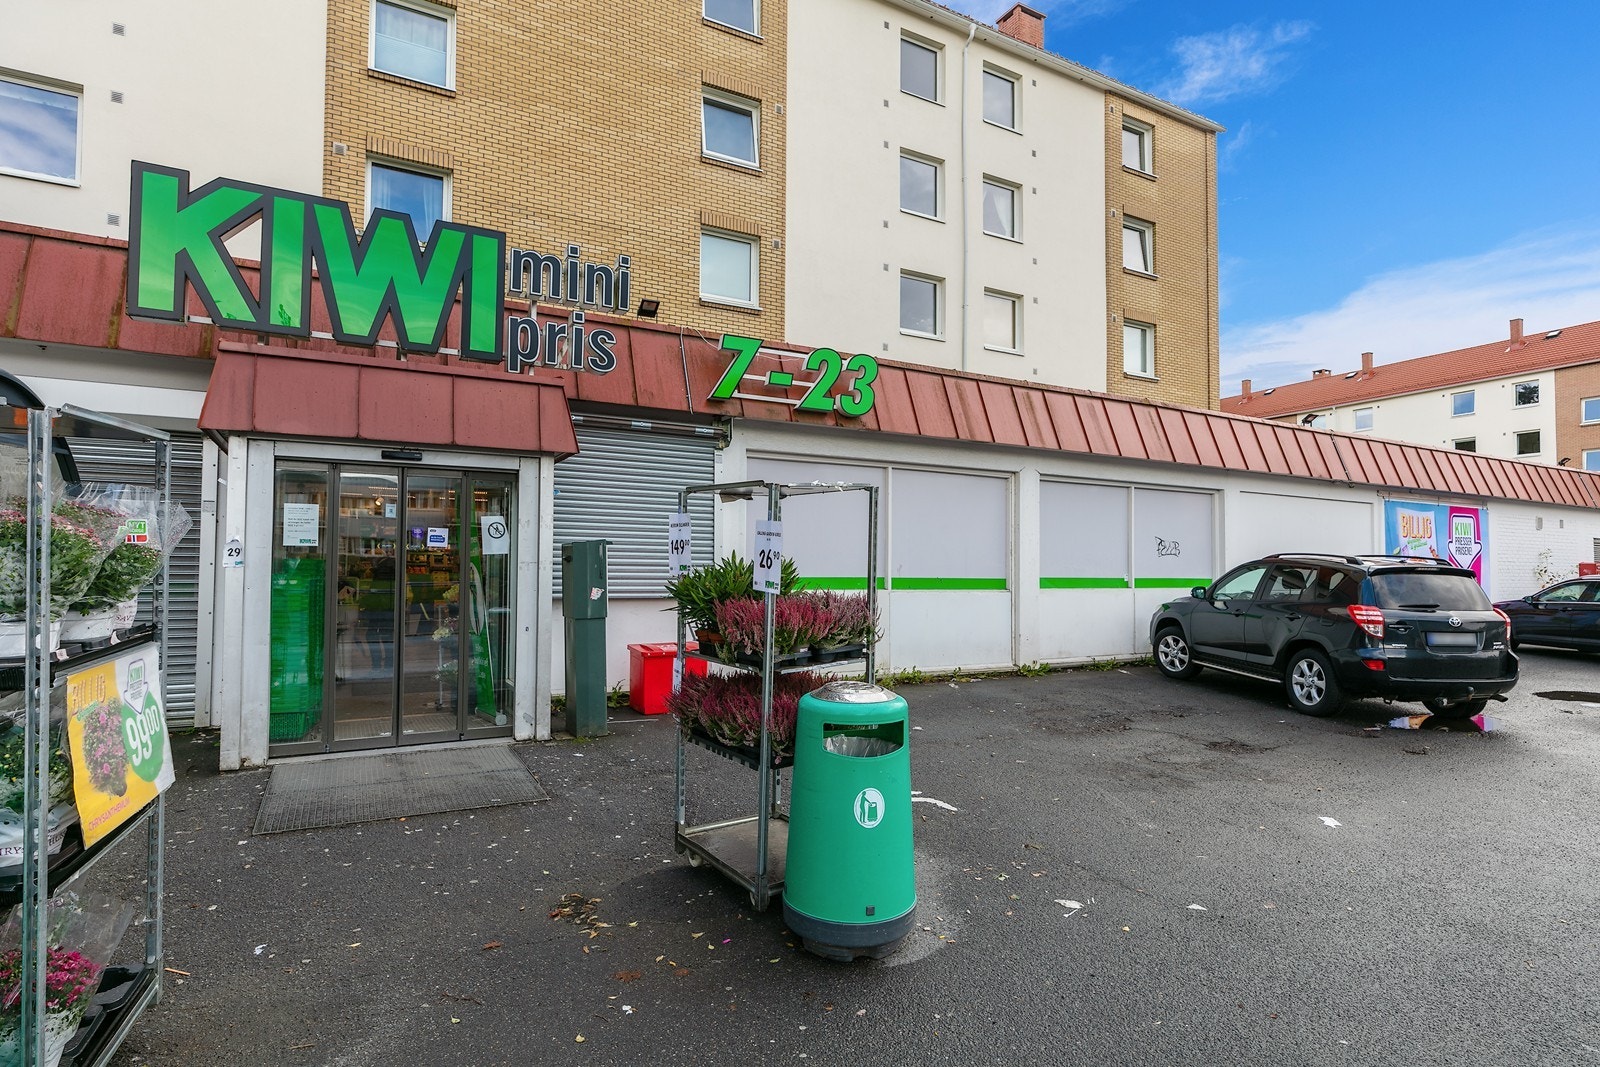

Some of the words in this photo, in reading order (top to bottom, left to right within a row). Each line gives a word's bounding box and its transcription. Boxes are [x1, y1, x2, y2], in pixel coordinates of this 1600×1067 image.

[127, 160, 506, 364] KIWI
[508, 244, 632, 315] mini
[507, 311, 618, 374] pris
[1401, 513, 1432, 539] BILLIG
[1454, 522, 1472, 536] KIWI
